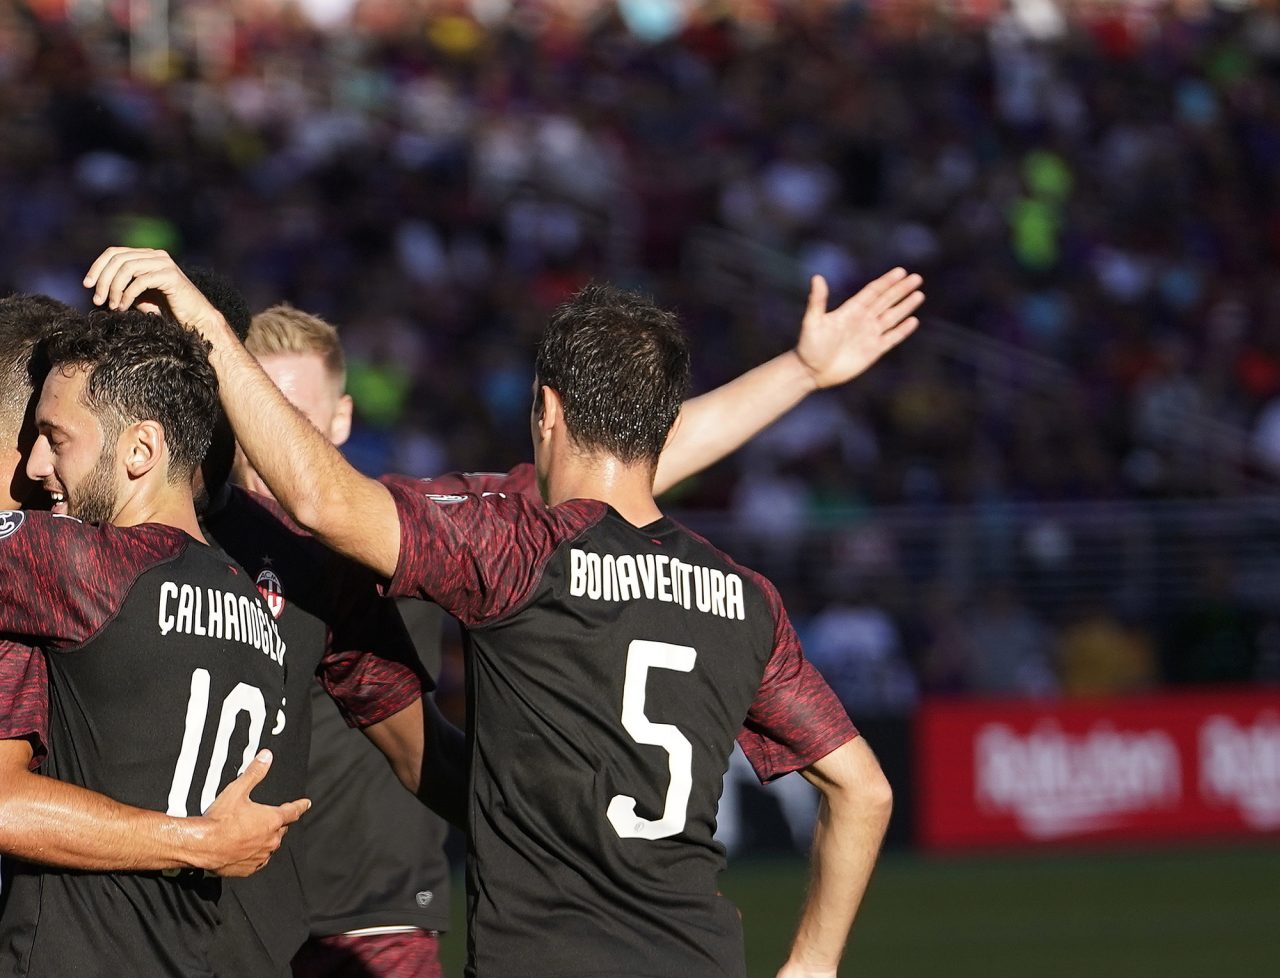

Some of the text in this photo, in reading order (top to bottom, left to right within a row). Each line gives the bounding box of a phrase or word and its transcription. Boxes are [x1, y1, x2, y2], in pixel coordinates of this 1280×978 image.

[570, 548, 746, 621] BONAVENTURA
[166, 667, 267, 819] 10
[606, 639, 698, 841] 5
